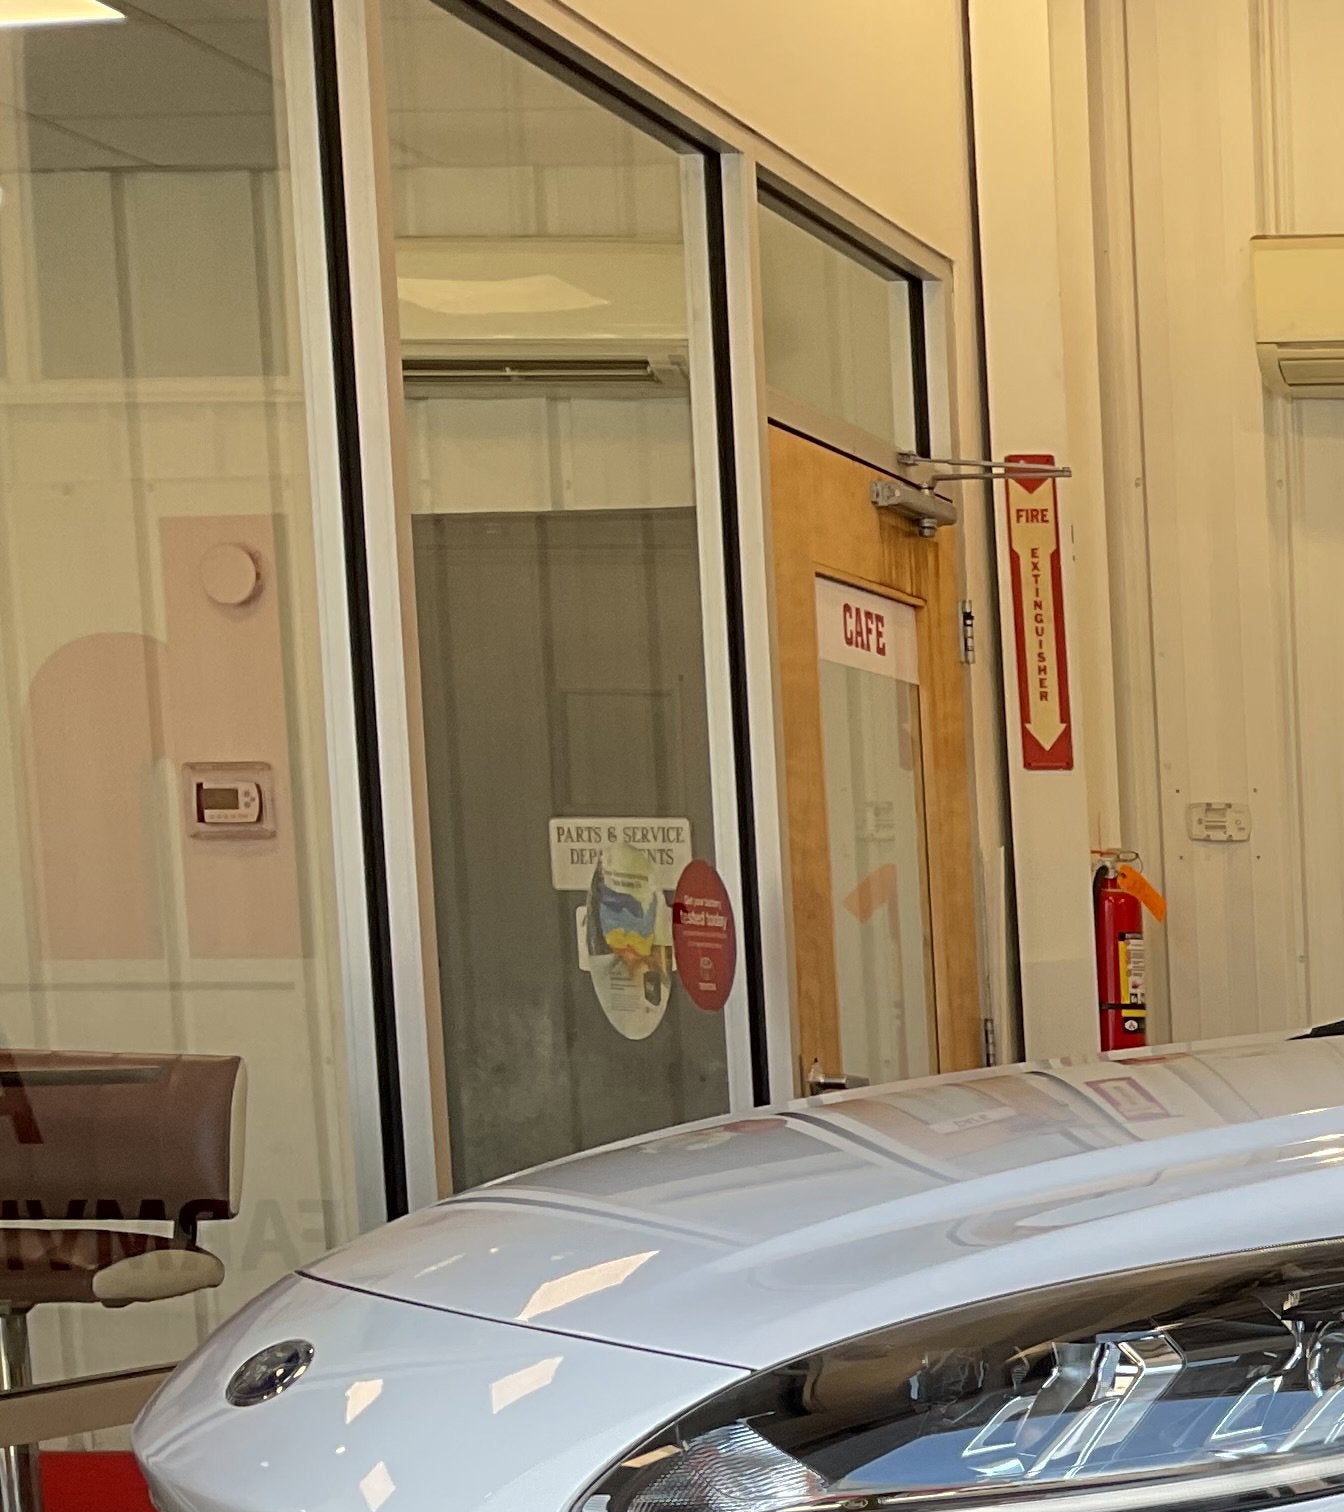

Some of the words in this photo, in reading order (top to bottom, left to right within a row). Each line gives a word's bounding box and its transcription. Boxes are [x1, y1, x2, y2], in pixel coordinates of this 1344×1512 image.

[1016, 508, 1049, 523] FIRE
[843, 603, 886, 656] CAFE
[1030, 547, 1049, 702] EXTINGUISHER
[556, 826, 602, 843] PARTS
[607, 826, 617, 843] &
[622, 826, 685, 843] SERVICE
[570, 848, 675, 865] DEPNTS
